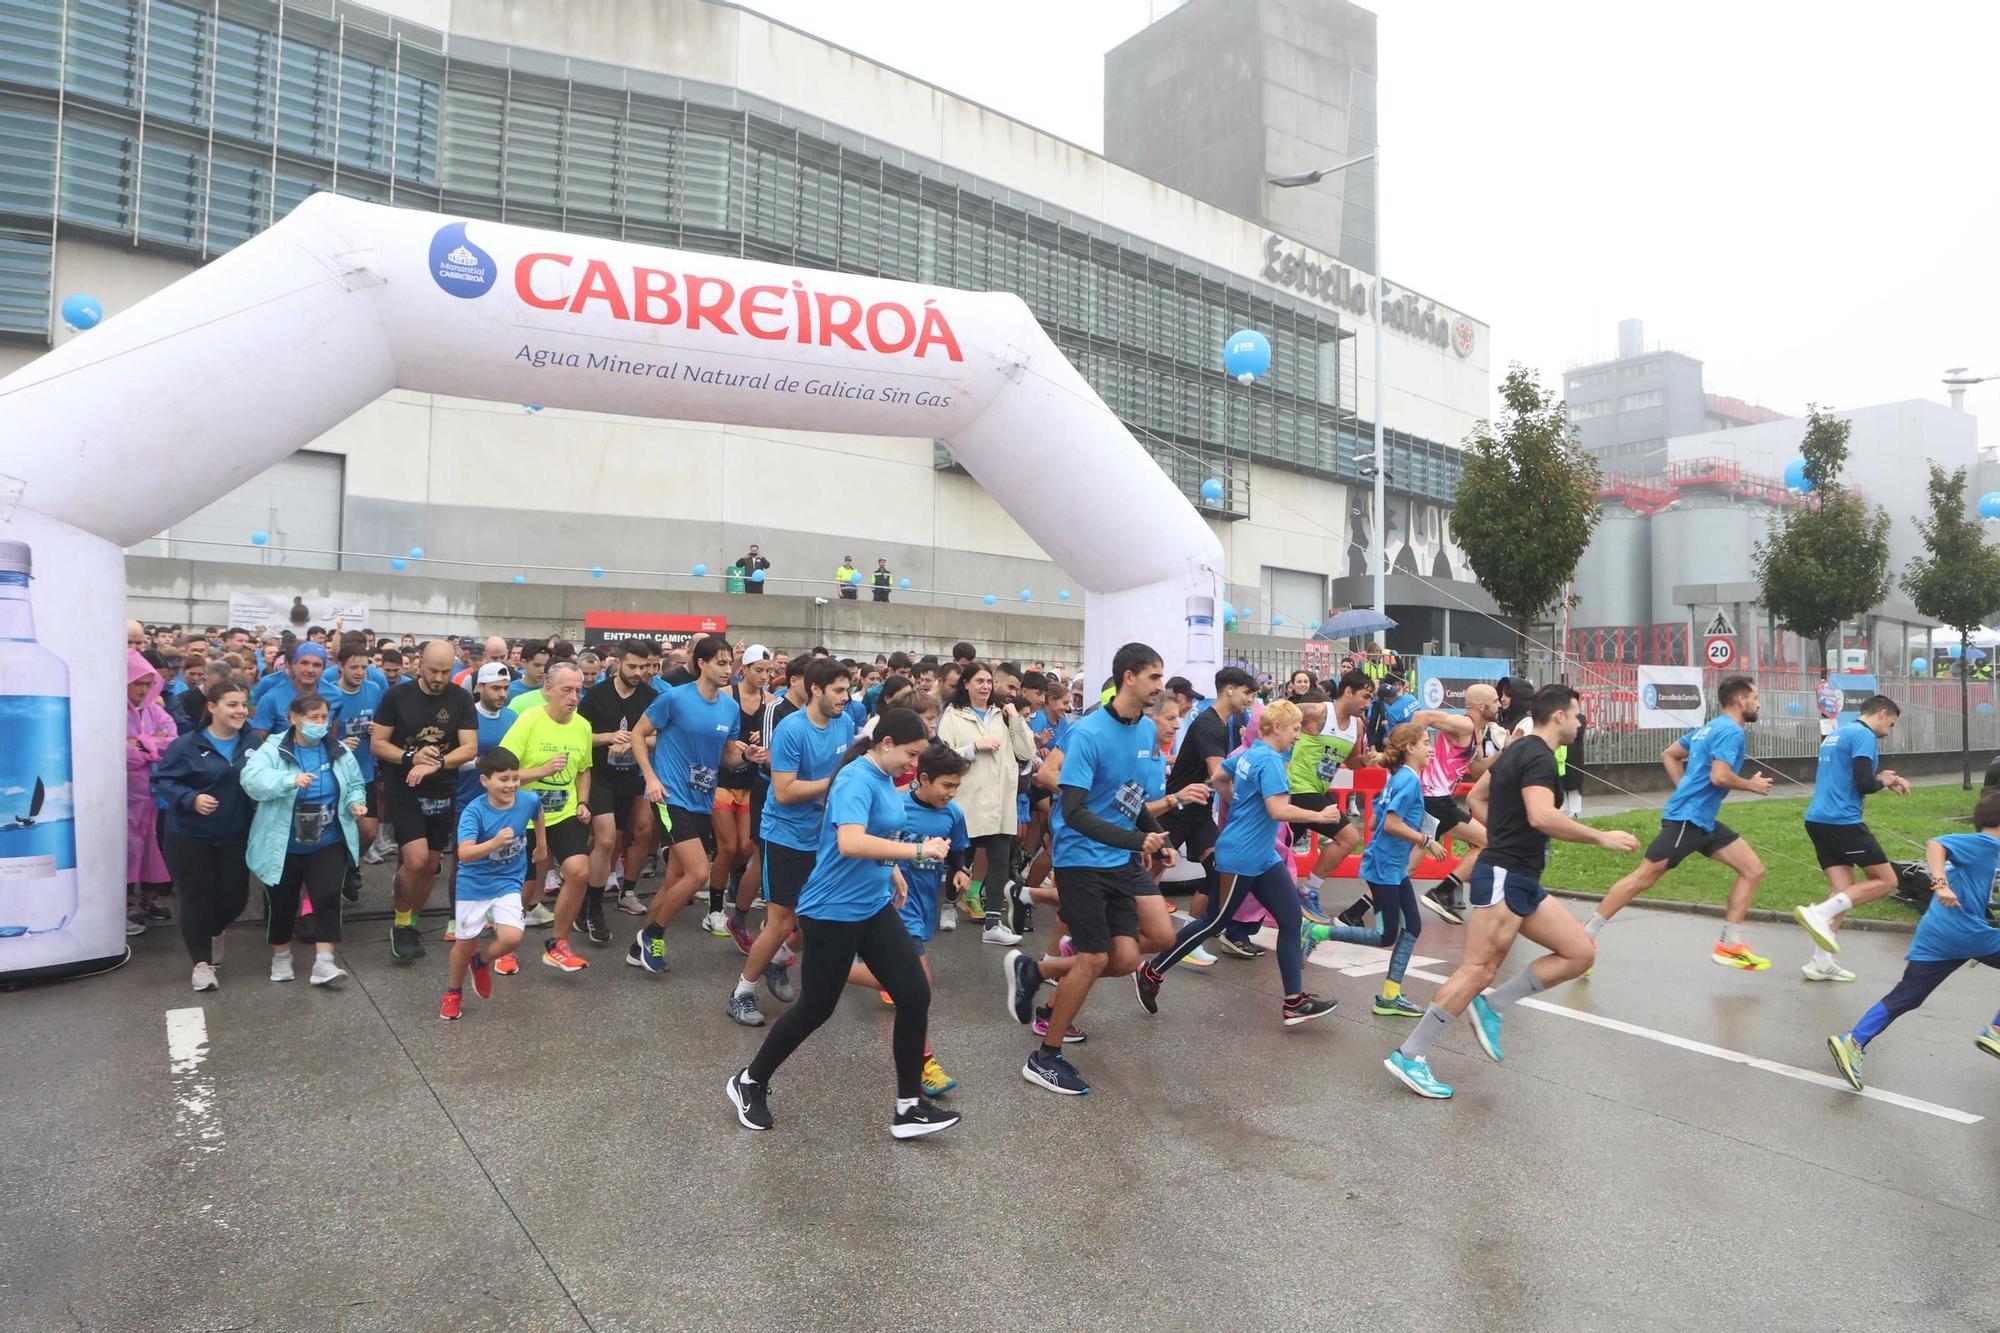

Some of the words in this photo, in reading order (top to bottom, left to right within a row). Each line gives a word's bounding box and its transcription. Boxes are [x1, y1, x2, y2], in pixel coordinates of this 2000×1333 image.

[440, 262, 485, 276] Manantial
[1260, 234, 1367, 316] Estrella
[515, 344, 579, 368] Agua
[586, 352, 679, 380] Mineral
[682, 364, 770, 390] Natural
[774, 375, 800, 393] de
[804, 380, 876, 400] Galicia
[879, 387, 911, 404] Sin
[915, 391, 952, 408] Gas
[603, 631, 652, 641] ENTRADA
[1711, 646, 1729, 658] 20
